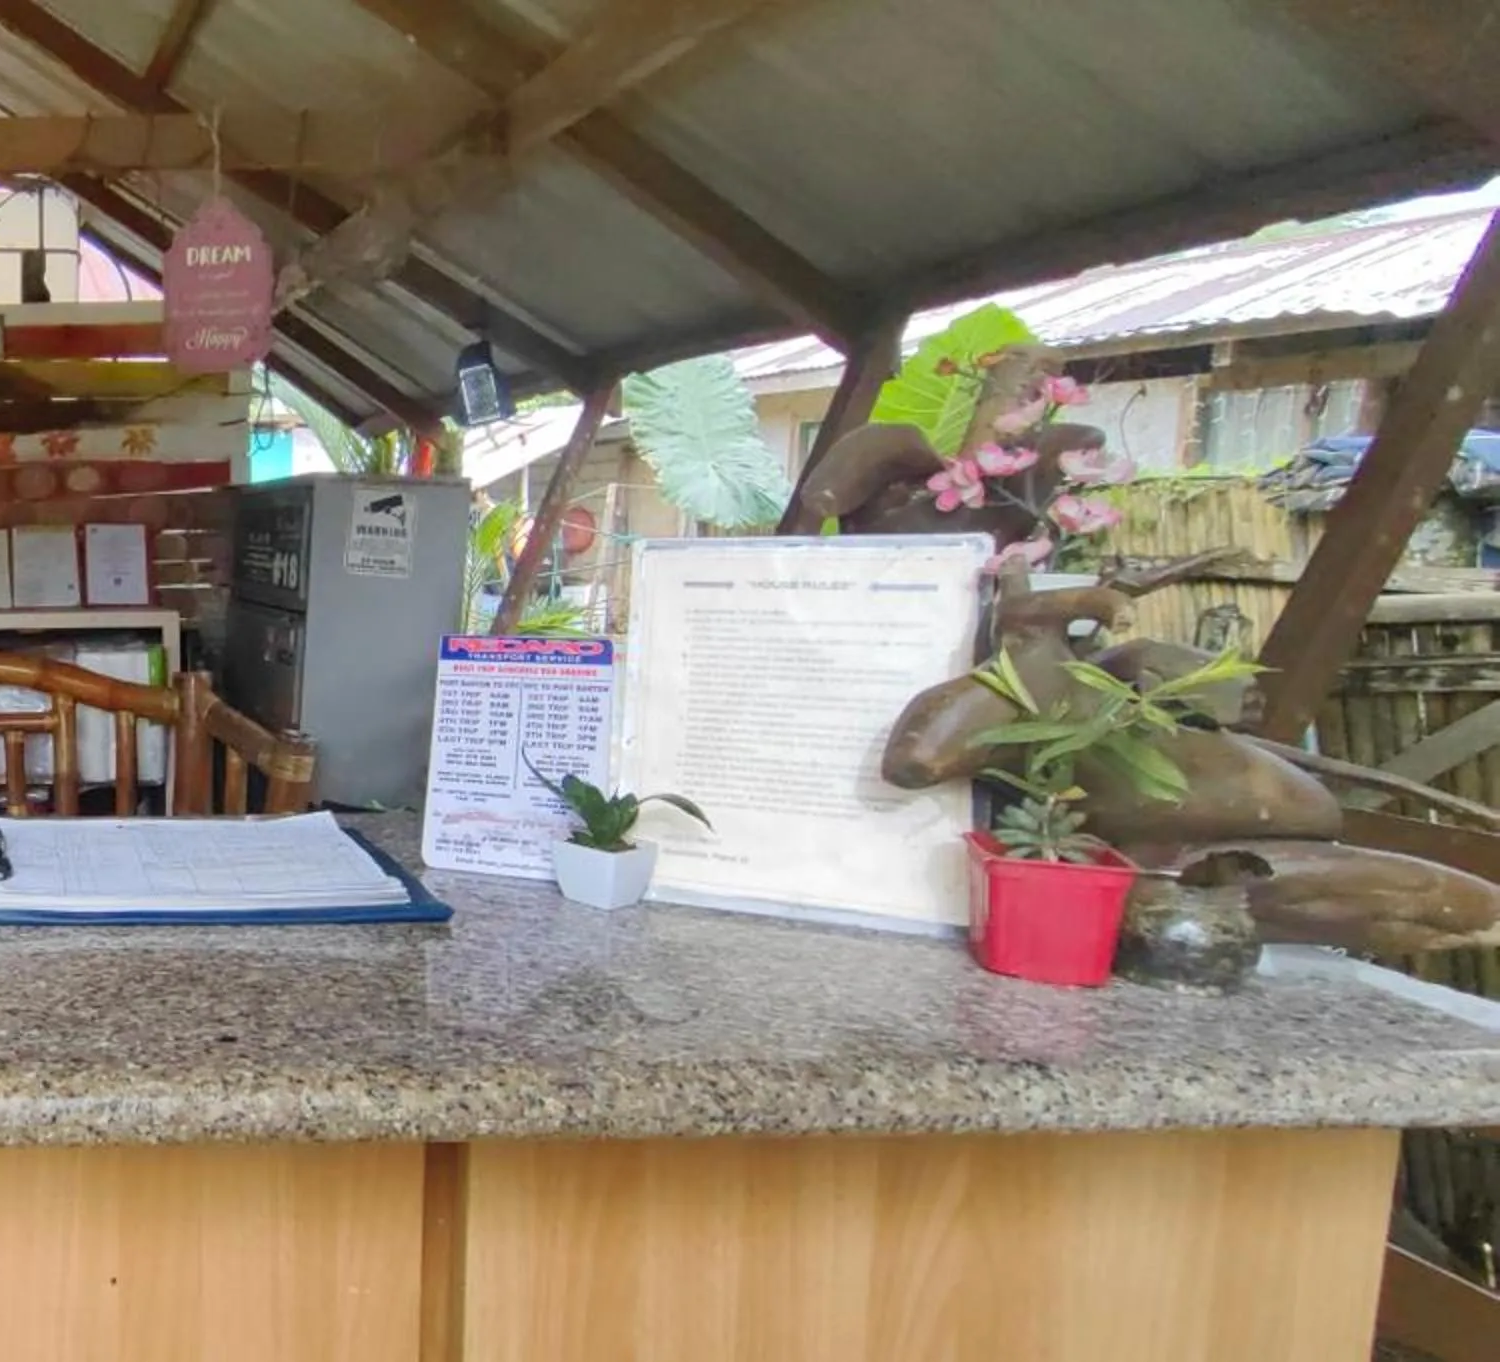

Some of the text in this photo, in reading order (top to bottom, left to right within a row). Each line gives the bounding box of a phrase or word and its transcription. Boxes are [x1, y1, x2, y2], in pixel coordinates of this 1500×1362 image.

[186, 245, 252, 267] DREAM
[356, 524, 408, 538] WARNING
[468, 653, 533, 662] TRANSPORT
